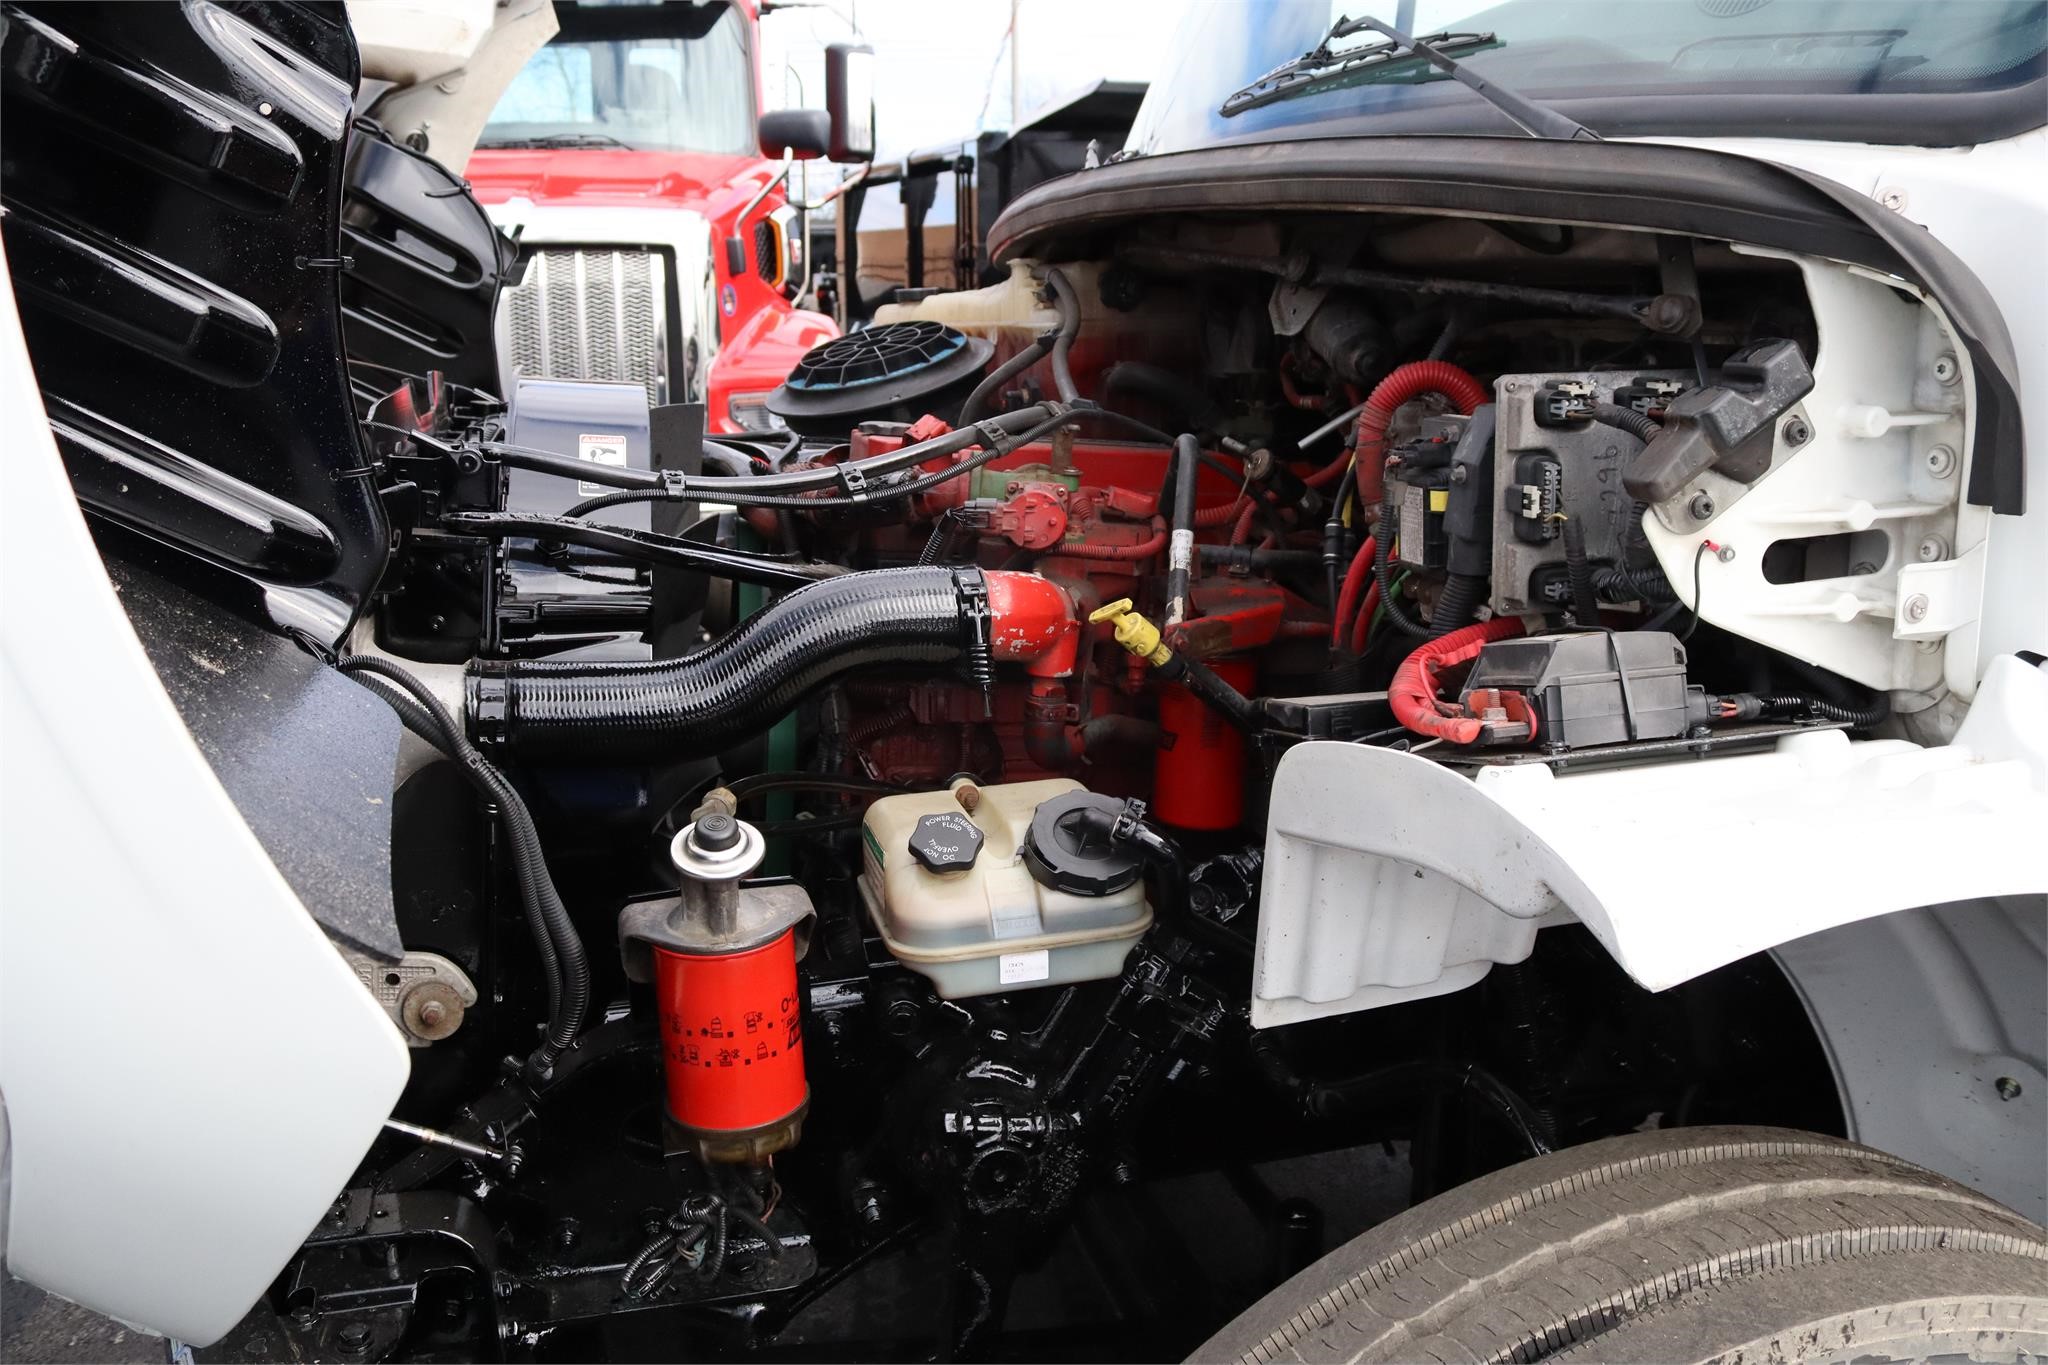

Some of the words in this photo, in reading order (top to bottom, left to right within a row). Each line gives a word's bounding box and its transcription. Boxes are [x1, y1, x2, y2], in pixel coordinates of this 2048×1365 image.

[925, 815, 951, 827] POWER
[954, 817, 978, 839] STEERING
[942, 821, 962, 832] FLUID
[928, 838, 959, 853] OVERFILL
[923, 847, 940, 858] NOT
